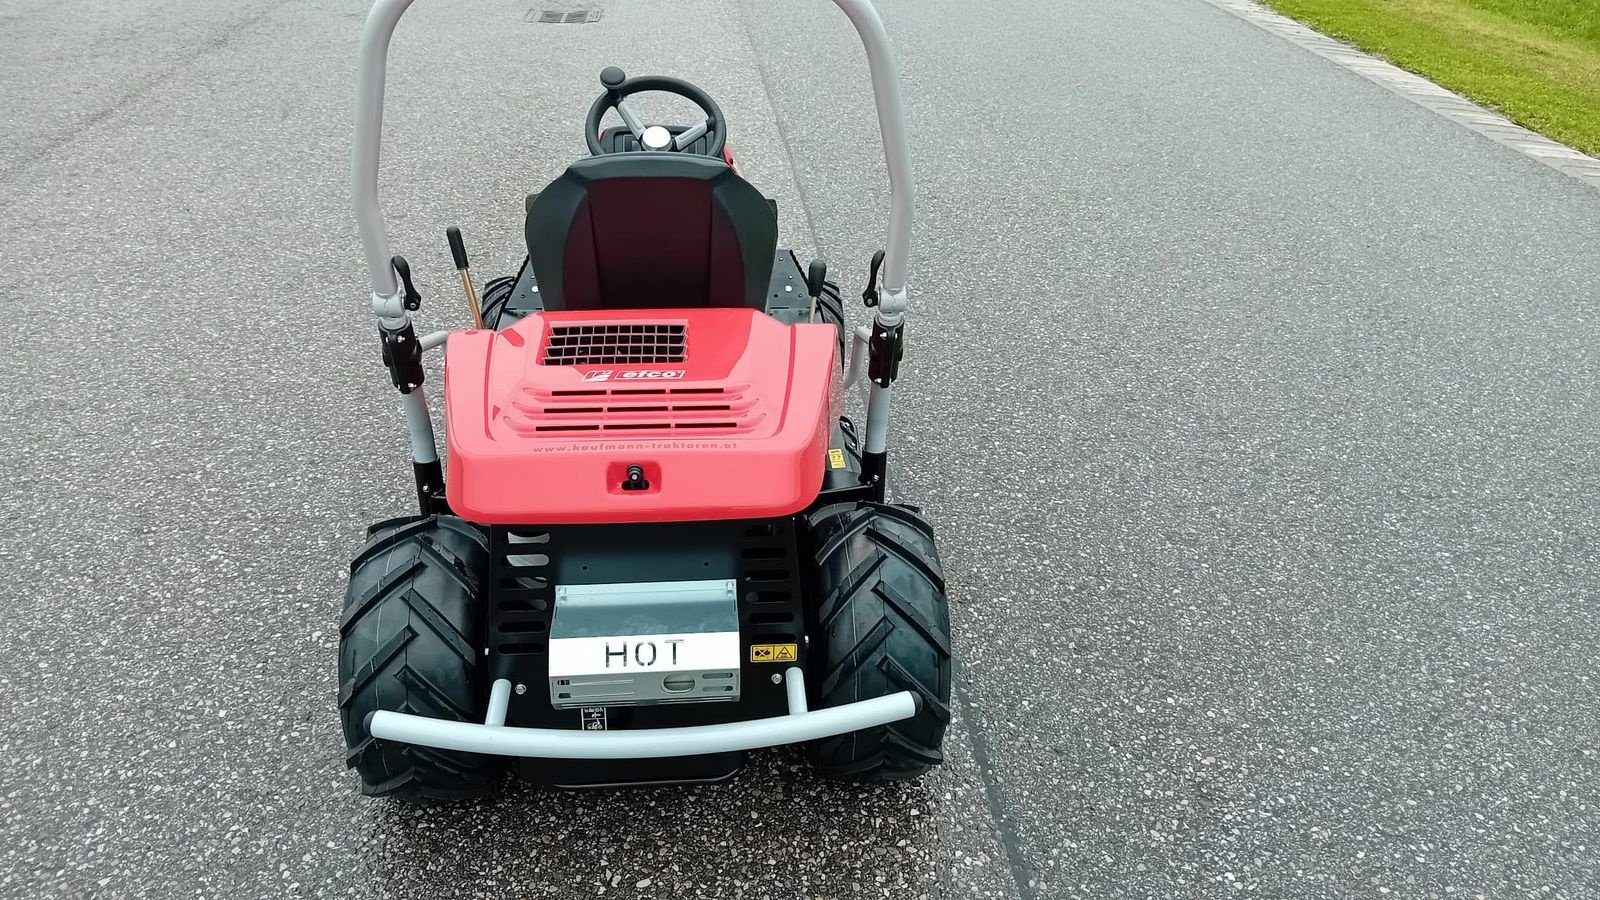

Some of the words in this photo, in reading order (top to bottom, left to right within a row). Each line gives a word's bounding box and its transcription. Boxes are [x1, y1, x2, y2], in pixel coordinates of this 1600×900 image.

[622, 370, 677, 378] efco
[533, 443, 738, 453] www.kaufmann-traktoren.at
[605, 639, 684, 668] HOT
